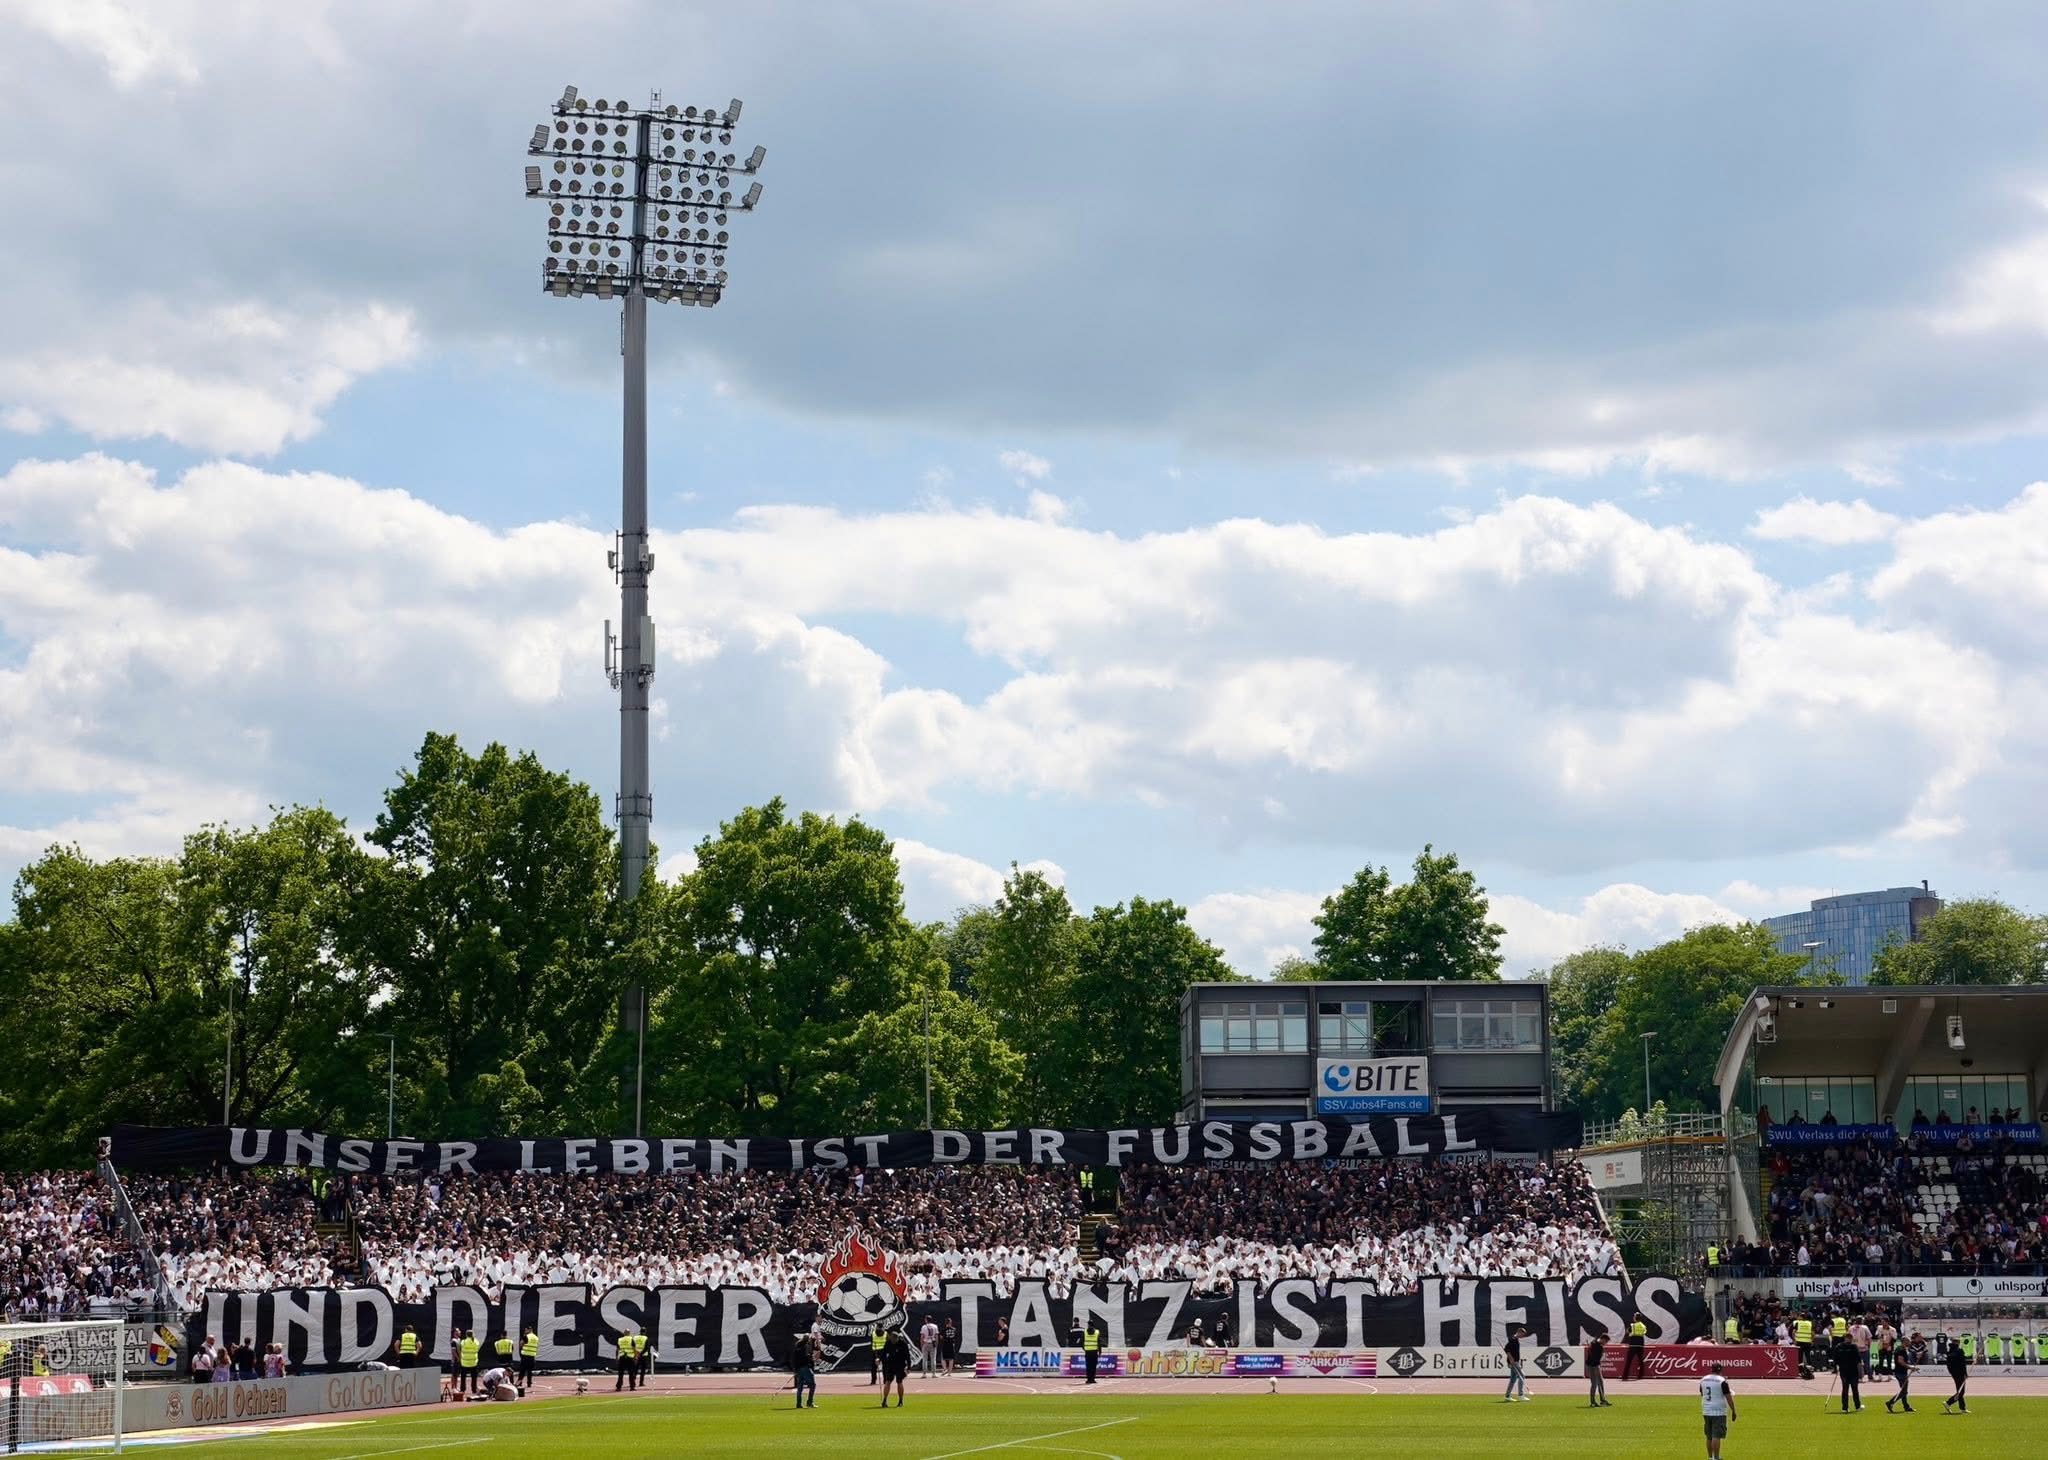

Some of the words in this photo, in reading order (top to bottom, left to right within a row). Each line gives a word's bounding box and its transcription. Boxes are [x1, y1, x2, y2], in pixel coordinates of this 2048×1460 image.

[1355, 1065, 1421, 1091] BITE
[1324, 1099, 1423, 1111] SSV.Jobs4Fans.de
[1799, 1131, 1835, 1140] Verlass
[2008, 1128, 2040, 1139] drauf.
[230, 1127, 478, 1175] UNSER
[521, 1138, 751, 1174] LEBEN
[789, 1133, 890, 1169] IST
[931, 1128, 1066, 1164] DER
[1106, 1114, 1477, 1167] FUSSBALL
[1795, 1281, 1850, 1295] uhlsp
[1868, 1281, 1925, 1294] uhlsport
[205, 1288, 394, 1366] UND
[429, 1284, 775, 1364] DIESER
[944, 1280, 1193, 1354] TANZ
[1236, 1278, 1376, 1348] IST
[1421, 1277, 1680, 1348] HEISS
[77, 1348, 147, 1367] SPATEN
[996, 1351, 1039, 1368] MEGA
[1433, 1353, 1527, 1370] Barfüßr
[1643, 1351, 1698, 1375] Hirsch
[1701, 1359, 1753, 1368] FINNINGEN
[328, 1377, 356, 1409] Go!
[360, 1375, 388, 1406] Go!
[391, 1372, 418, 1404] Go!
[191, 1388, 228, 1421] Gold
[232, 1384, 287, 1417] Ochsen
